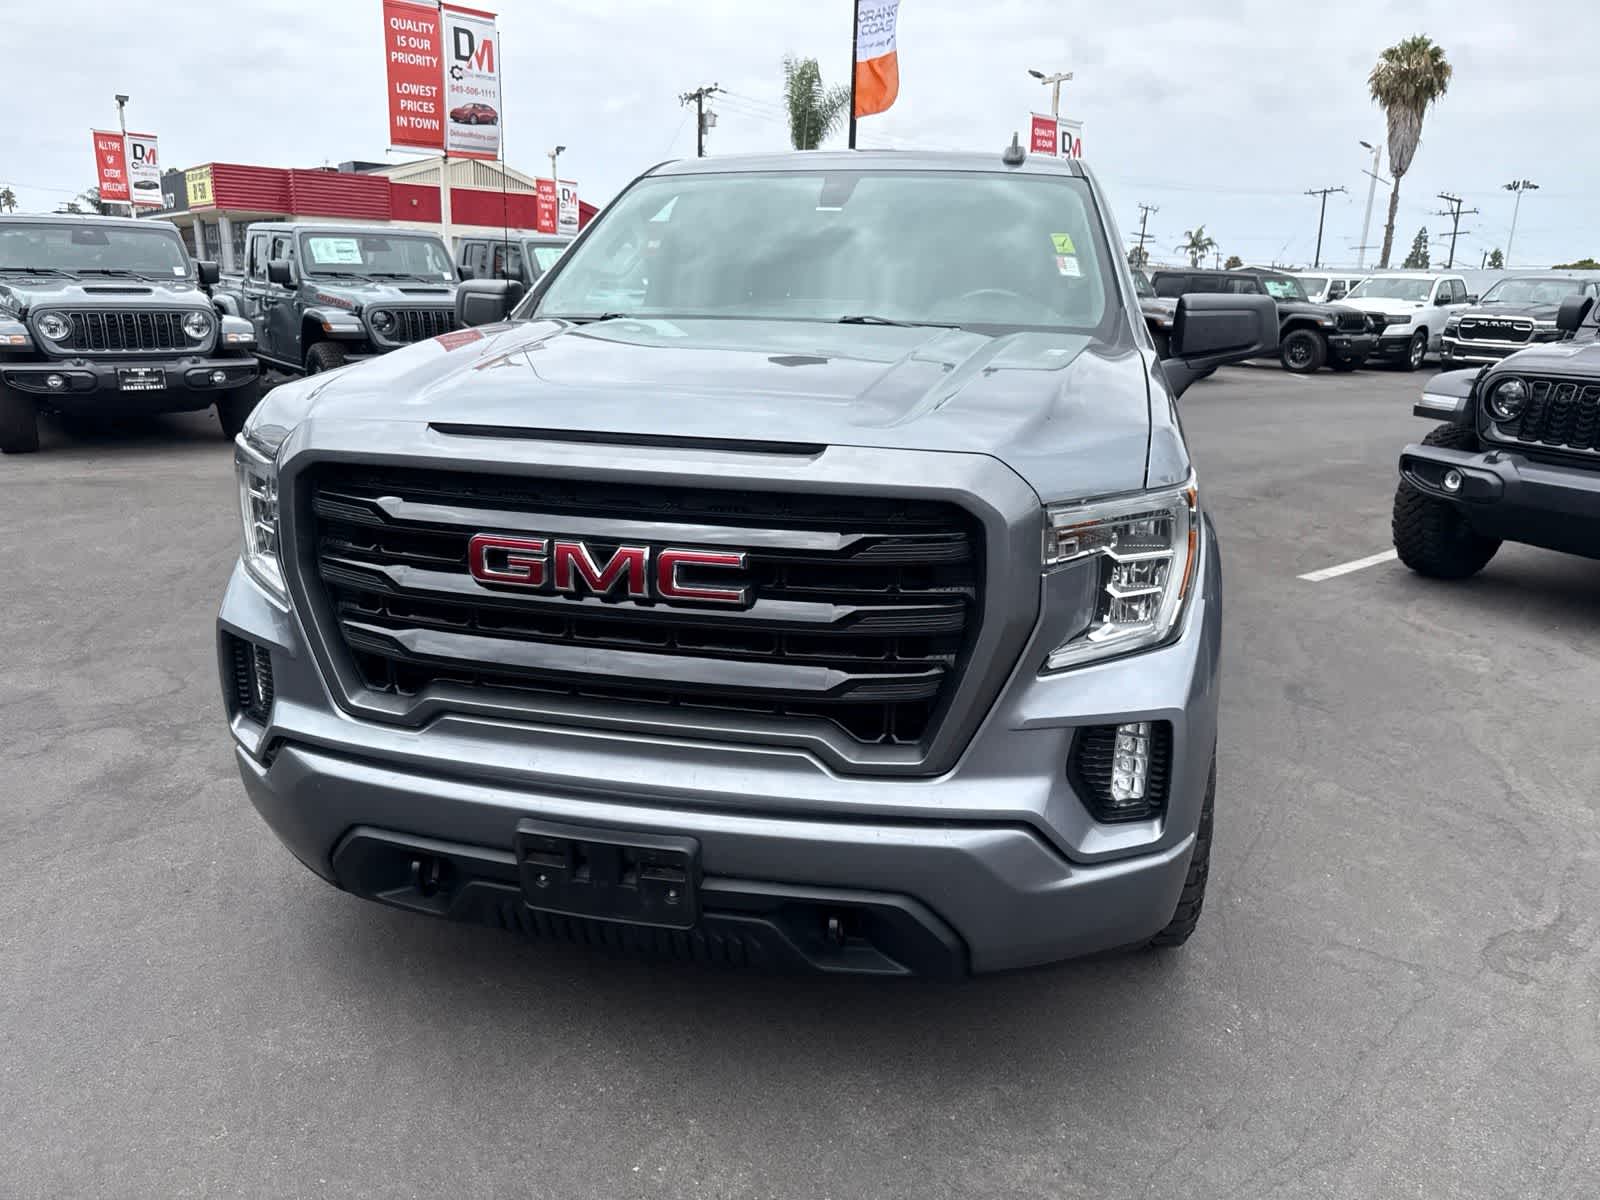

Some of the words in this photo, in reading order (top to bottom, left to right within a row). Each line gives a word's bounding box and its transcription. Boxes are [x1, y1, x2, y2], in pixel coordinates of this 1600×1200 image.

[390, 17, 435, 34] QUALITY
[397, 35, 407, 47] IS
[408, 37, 431, 51] OUR
[453, 26, 494, 73] DM
[391, 51, 438, 68] PRIORITY
[396, 82, 437, 97] LOWEST
[400, 99, 435, 113] PRICES
[396, 115, 408, 127] IN
[409, 117, 440, 131] TOWN
[98, 140, 109, 150] ALL
[108, 143, 121, 152] TYPE
[106, 155, 114, 165] OF
[103, 168, 121, 179] CREDIT
[102, 182, 128, 193] WELCOME
[467, 532, 751, 606] GMC
